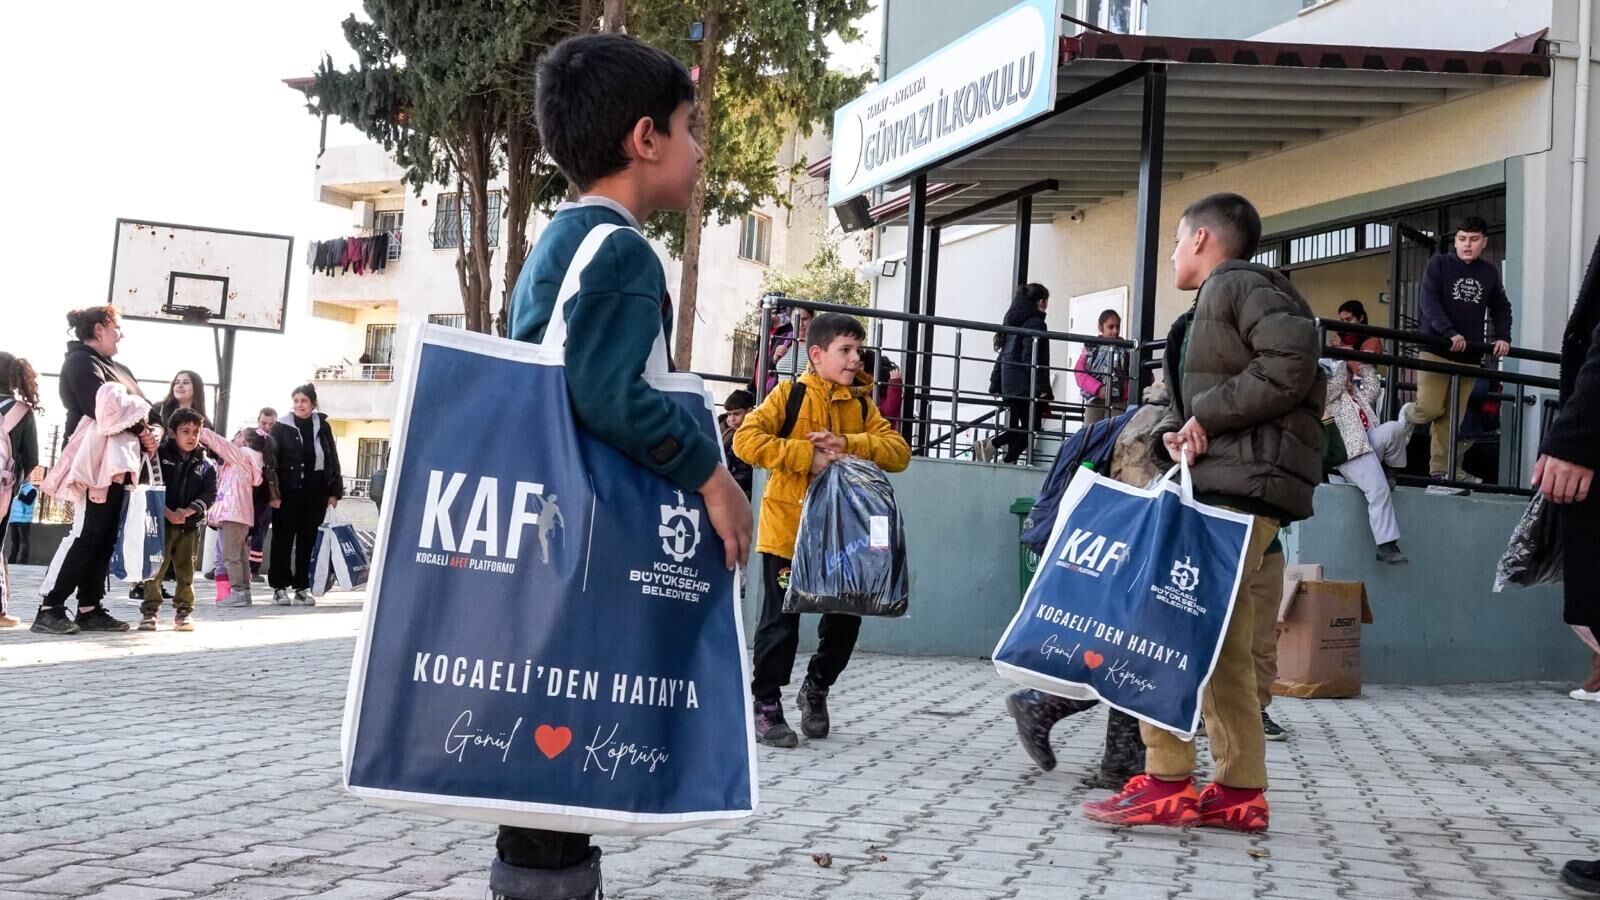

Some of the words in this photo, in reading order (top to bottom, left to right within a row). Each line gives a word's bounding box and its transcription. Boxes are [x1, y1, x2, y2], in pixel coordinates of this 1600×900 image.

[863, 102, 934, 171] GÜNYAZI
[936, 51, 1036, 137] İLKOKULU
[418, 469, 544, 560] KAF
[413, 551, 449, 566] KOCAELİ
[449, 555, 470, 568] AFET
[469, 558, 516, 574] PLATFORMU
[653, 561, 699, 578] KOCAELİ
[1059, 528, 1128, 572] KAF
[629, 569, 711, 593] BÜYÜKŞEHİR
[641, 584, 700, 603] BELEDİYESİ
[1036, 603, 1124, 646] KOCAELİ'DEN
[1127, 634, 1188, 671] HATAY'A
[413, 651, 600, 701] KOCAELİ'DEN
[611, 673, 699, 709] HATAY'A
[444, 709, 523, 763] Gönül
[583, 722, 670, 780] Köprüsü
